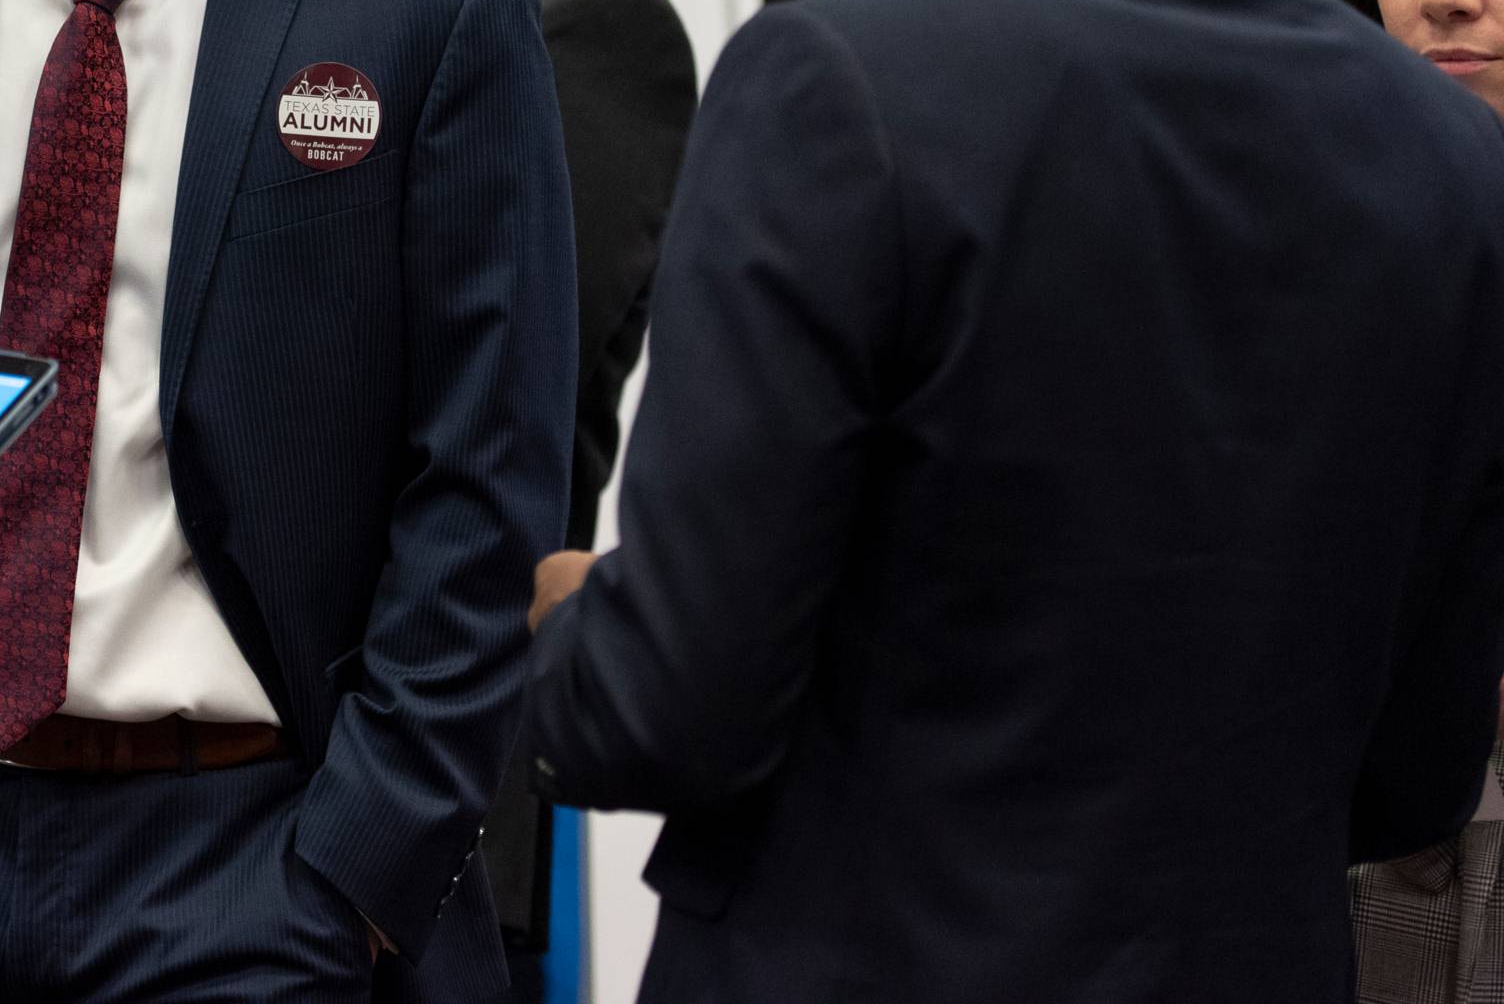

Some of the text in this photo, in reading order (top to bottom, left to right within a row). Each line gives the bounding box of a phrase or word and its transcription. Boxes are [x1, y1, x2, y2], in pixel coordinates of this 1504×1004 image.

[284, 100, 375, 117] TEXAS STATE
[282, 111, 372, 134] ALUMNI
[290, 139, 306, 147] Once
[336, 143, 357, 152] always
[307, 149, 344, 161] BOBCAT
